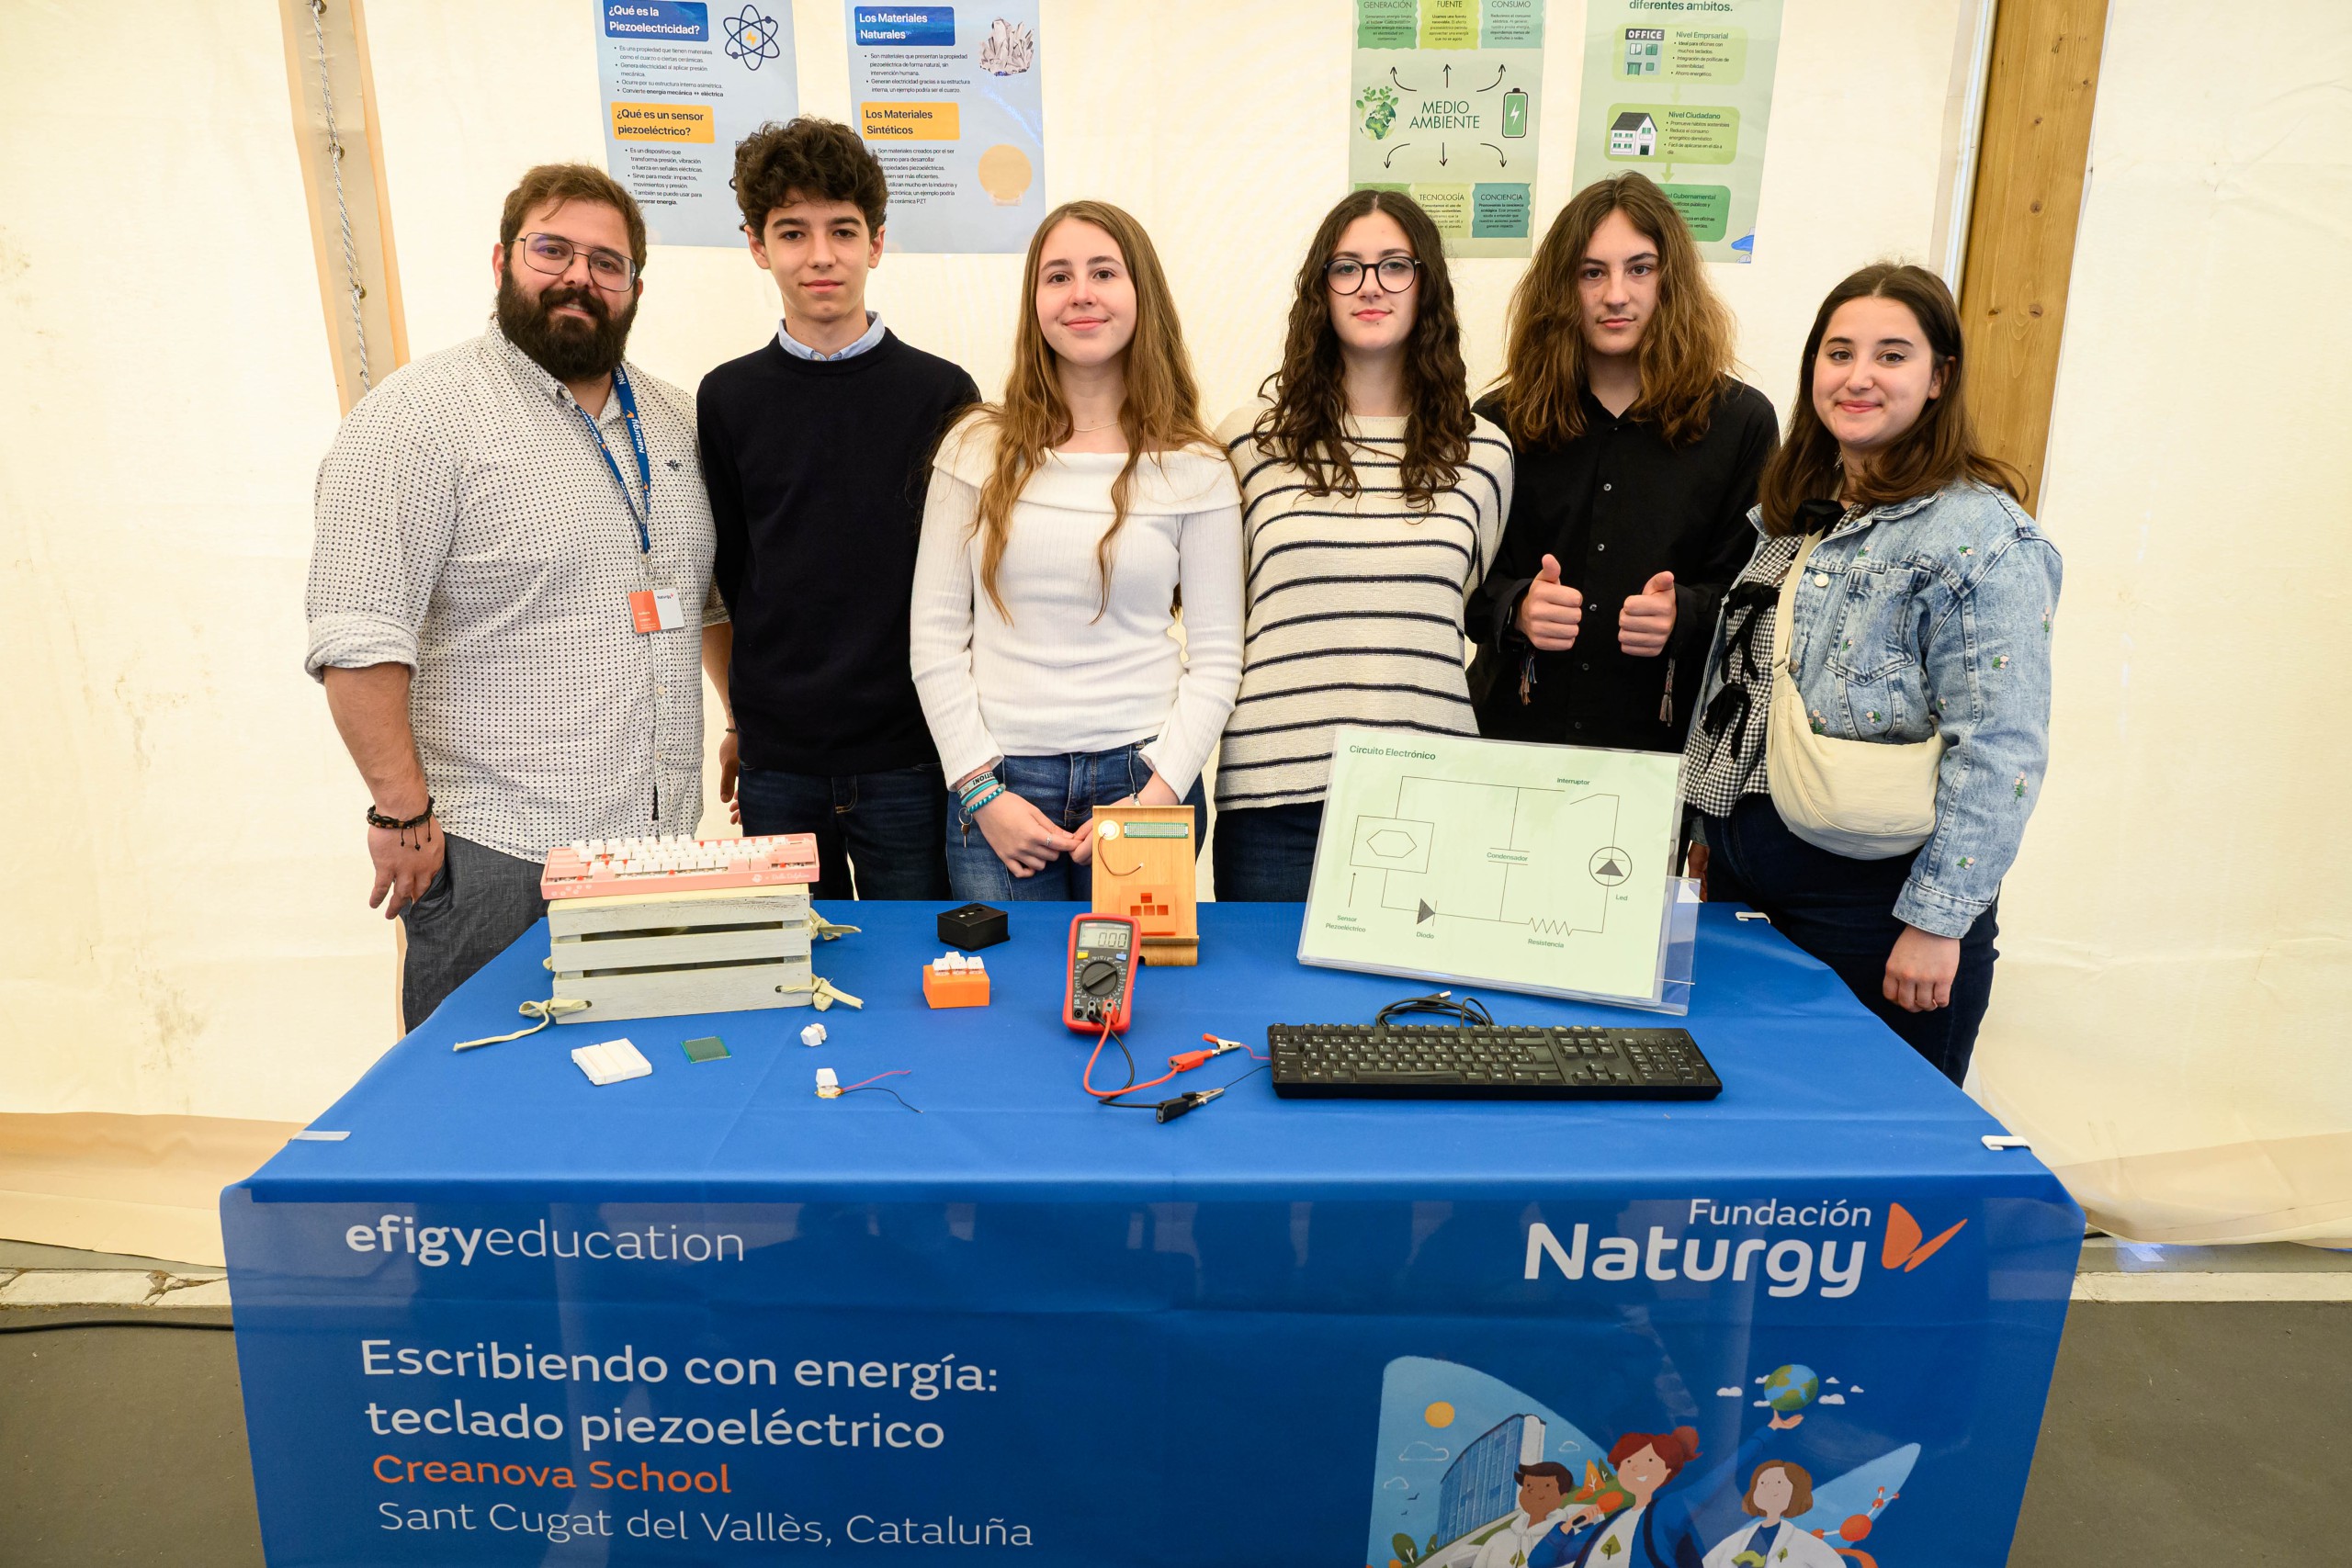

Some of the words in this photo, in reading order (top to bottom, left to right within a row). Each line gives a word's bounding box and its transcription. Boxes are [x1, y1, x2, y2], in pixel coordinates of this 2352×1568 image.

[1364, 0, 1412, 9] GENERACIÓN
[1629, 0, 1684, 10] diferentes
[1687, 1, 1733, 11] ambitos.
[609, 6, 634, 16] ¿Qué
[650, 7, 659, 16] la
[859, 13, 876, 22] Los
[878, 13, 927, 23] Materiales
[610, 22, 700, 34] Piezoelectricidad?
[860, 30, 906, 39] Naturales
[1628, 30, 1662, 39] OFFICE
[1421, 101, 1470, 114] MEDIO
[617, 109, 641, 119] ¿Qué
[866, 110, 882, 118] Los
[884, 110, 933, 118] Materiales
[1409, 115, 1480, 129] AMBIENTE
[618, 125, 691, 137] piezoeléctrico?
[867, 125, 913, 134] Sintéticos
[1419, 193, 1464, 201] TECNOLOGÍA
[631, 419, 645, 453] Naturgy
[1349, 745, 1384, 755] Circuito
[1385, 748, 1436, 760] Electrónico
[1487, 852, 1528, 861] Condensador
[1326, 923, 1366, 932] Piezoeléctrico
[1528, 939, 1564, 948] Resistencia
[1689, 1198, 1871, 1226] Fundación
[346, 1214, 744, 1267] efigyeducation
[1524, 1222, 1867, 1298] Naturgy
[361, 1339, 667, 1383] Escribiendo
[684, 1356, 776, 1385] con
[794, 1354, 997, 1401] energía:
[365, 1400, 563, 1438] teclado
[582, 1409, 944, 1450] piezoeléctrico
[373, 1454, 576, 1488] Creanova
[590, 1461, 732, 1493] School
[379, 1502, 475, 1530] Sant
[490, 1504, 613, 1543] Cugat
[627, 1508, 689, 1539] del
[700, 1512, 832, 1546] Vallès,
[846, 1515, 1035, 1546] Cataluña
